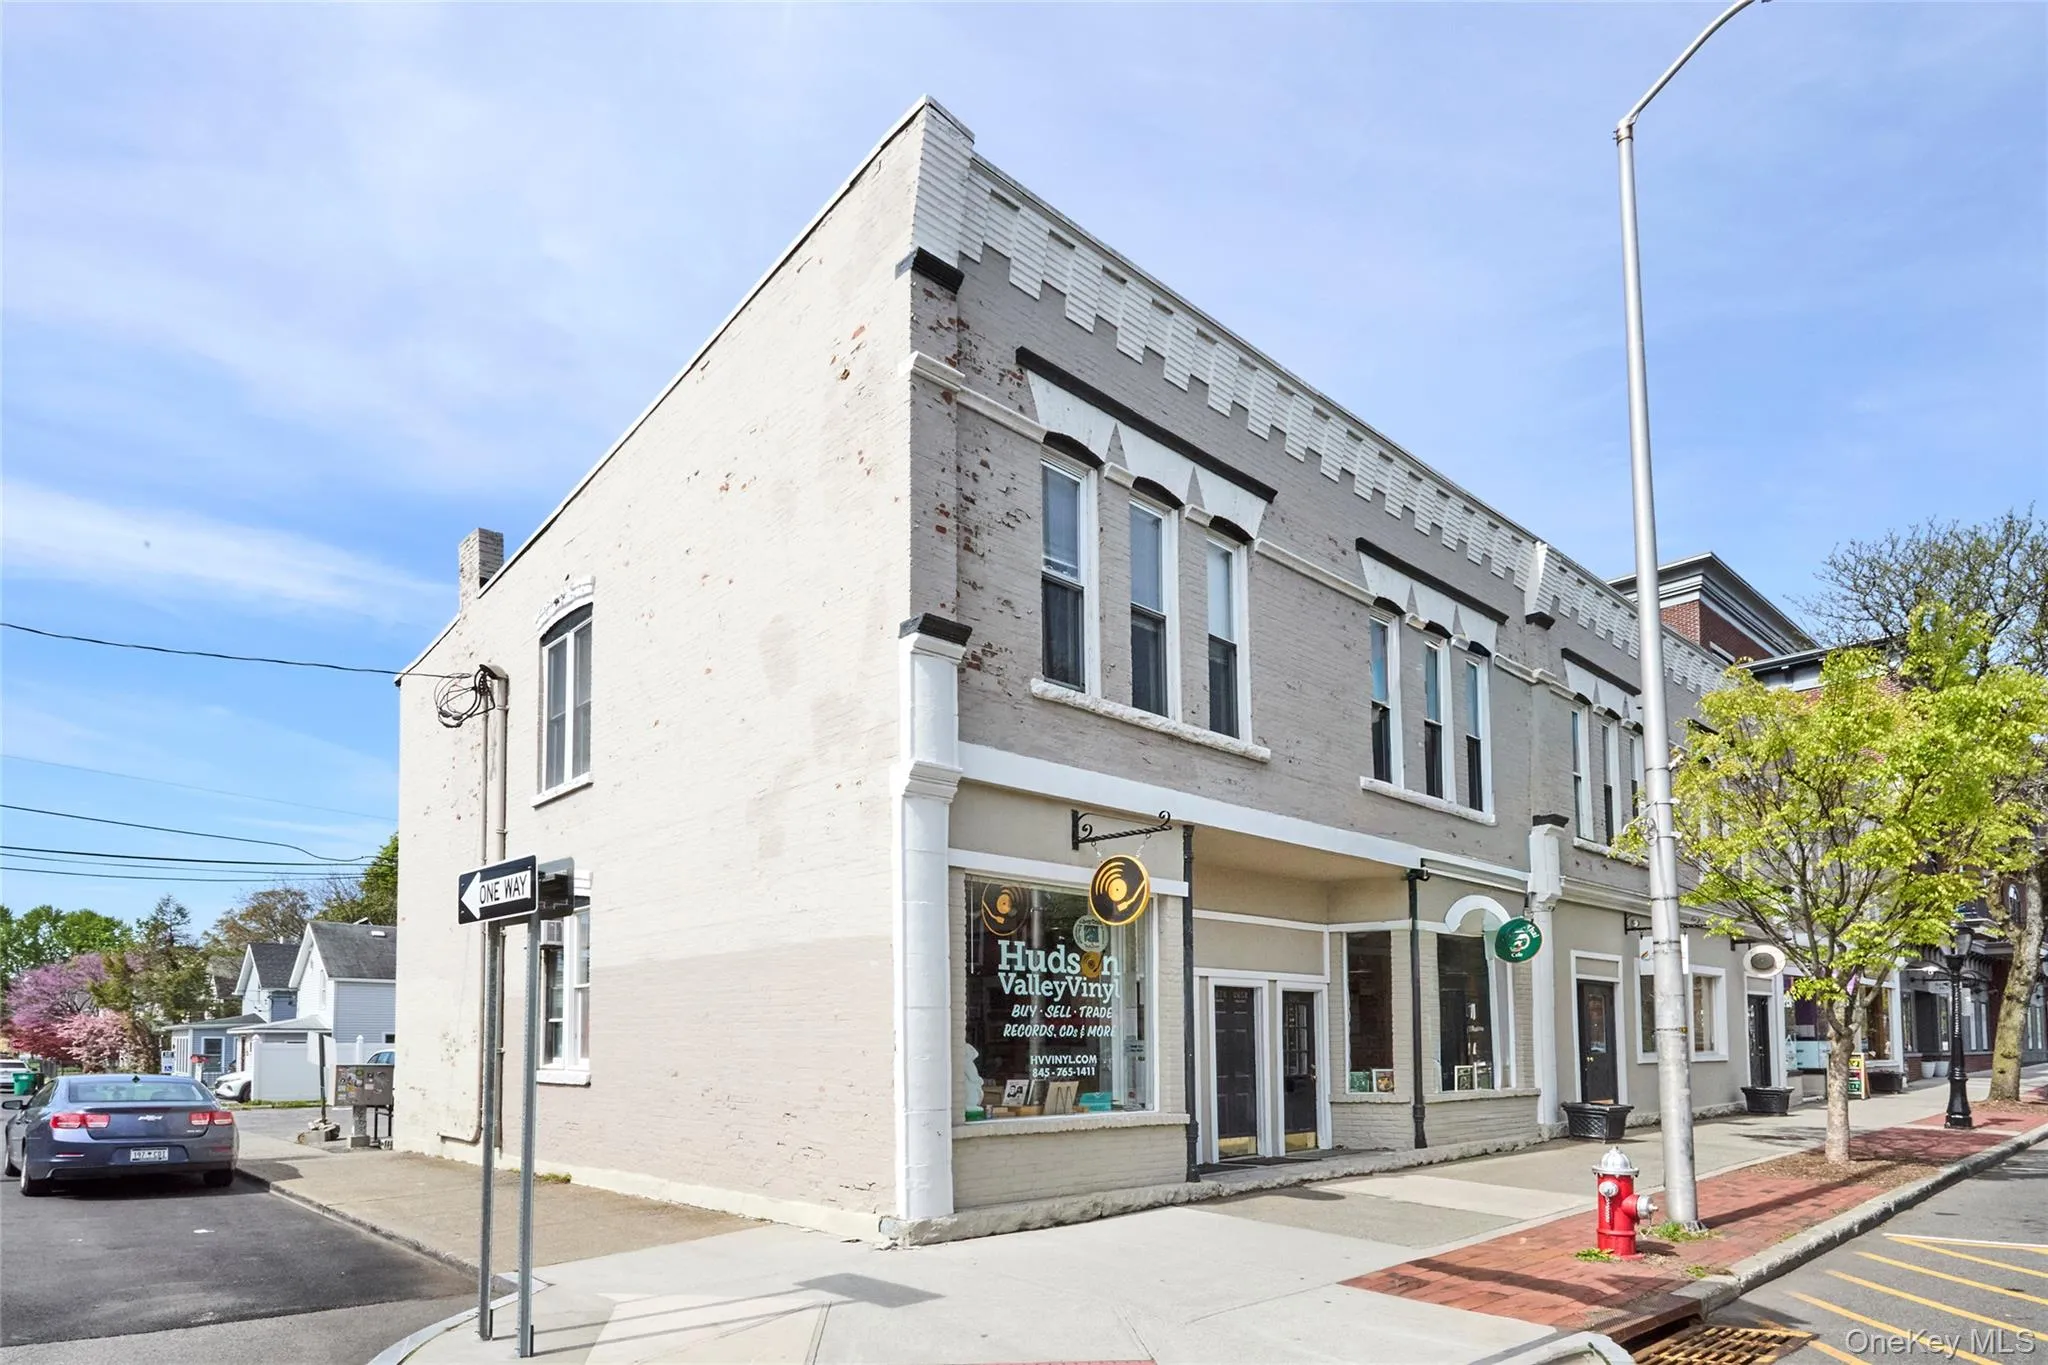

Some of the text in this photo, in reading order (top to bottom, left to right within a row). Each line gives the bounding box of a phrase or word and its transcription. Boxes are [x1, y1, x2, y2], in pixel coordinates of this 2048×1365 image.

[480, 874, 527, 904] ONE WAY
[998, 939, 1120, 978] Hudson
[1011, 1004, 1113, 1019] BUY SELL TRADE
[1003, 1023, 1057, 1038] RECORDS,
[1087, 1025, 1117, 1038] MORE
[1030, 1054, 1098, 1065] HVVINYL.COM
